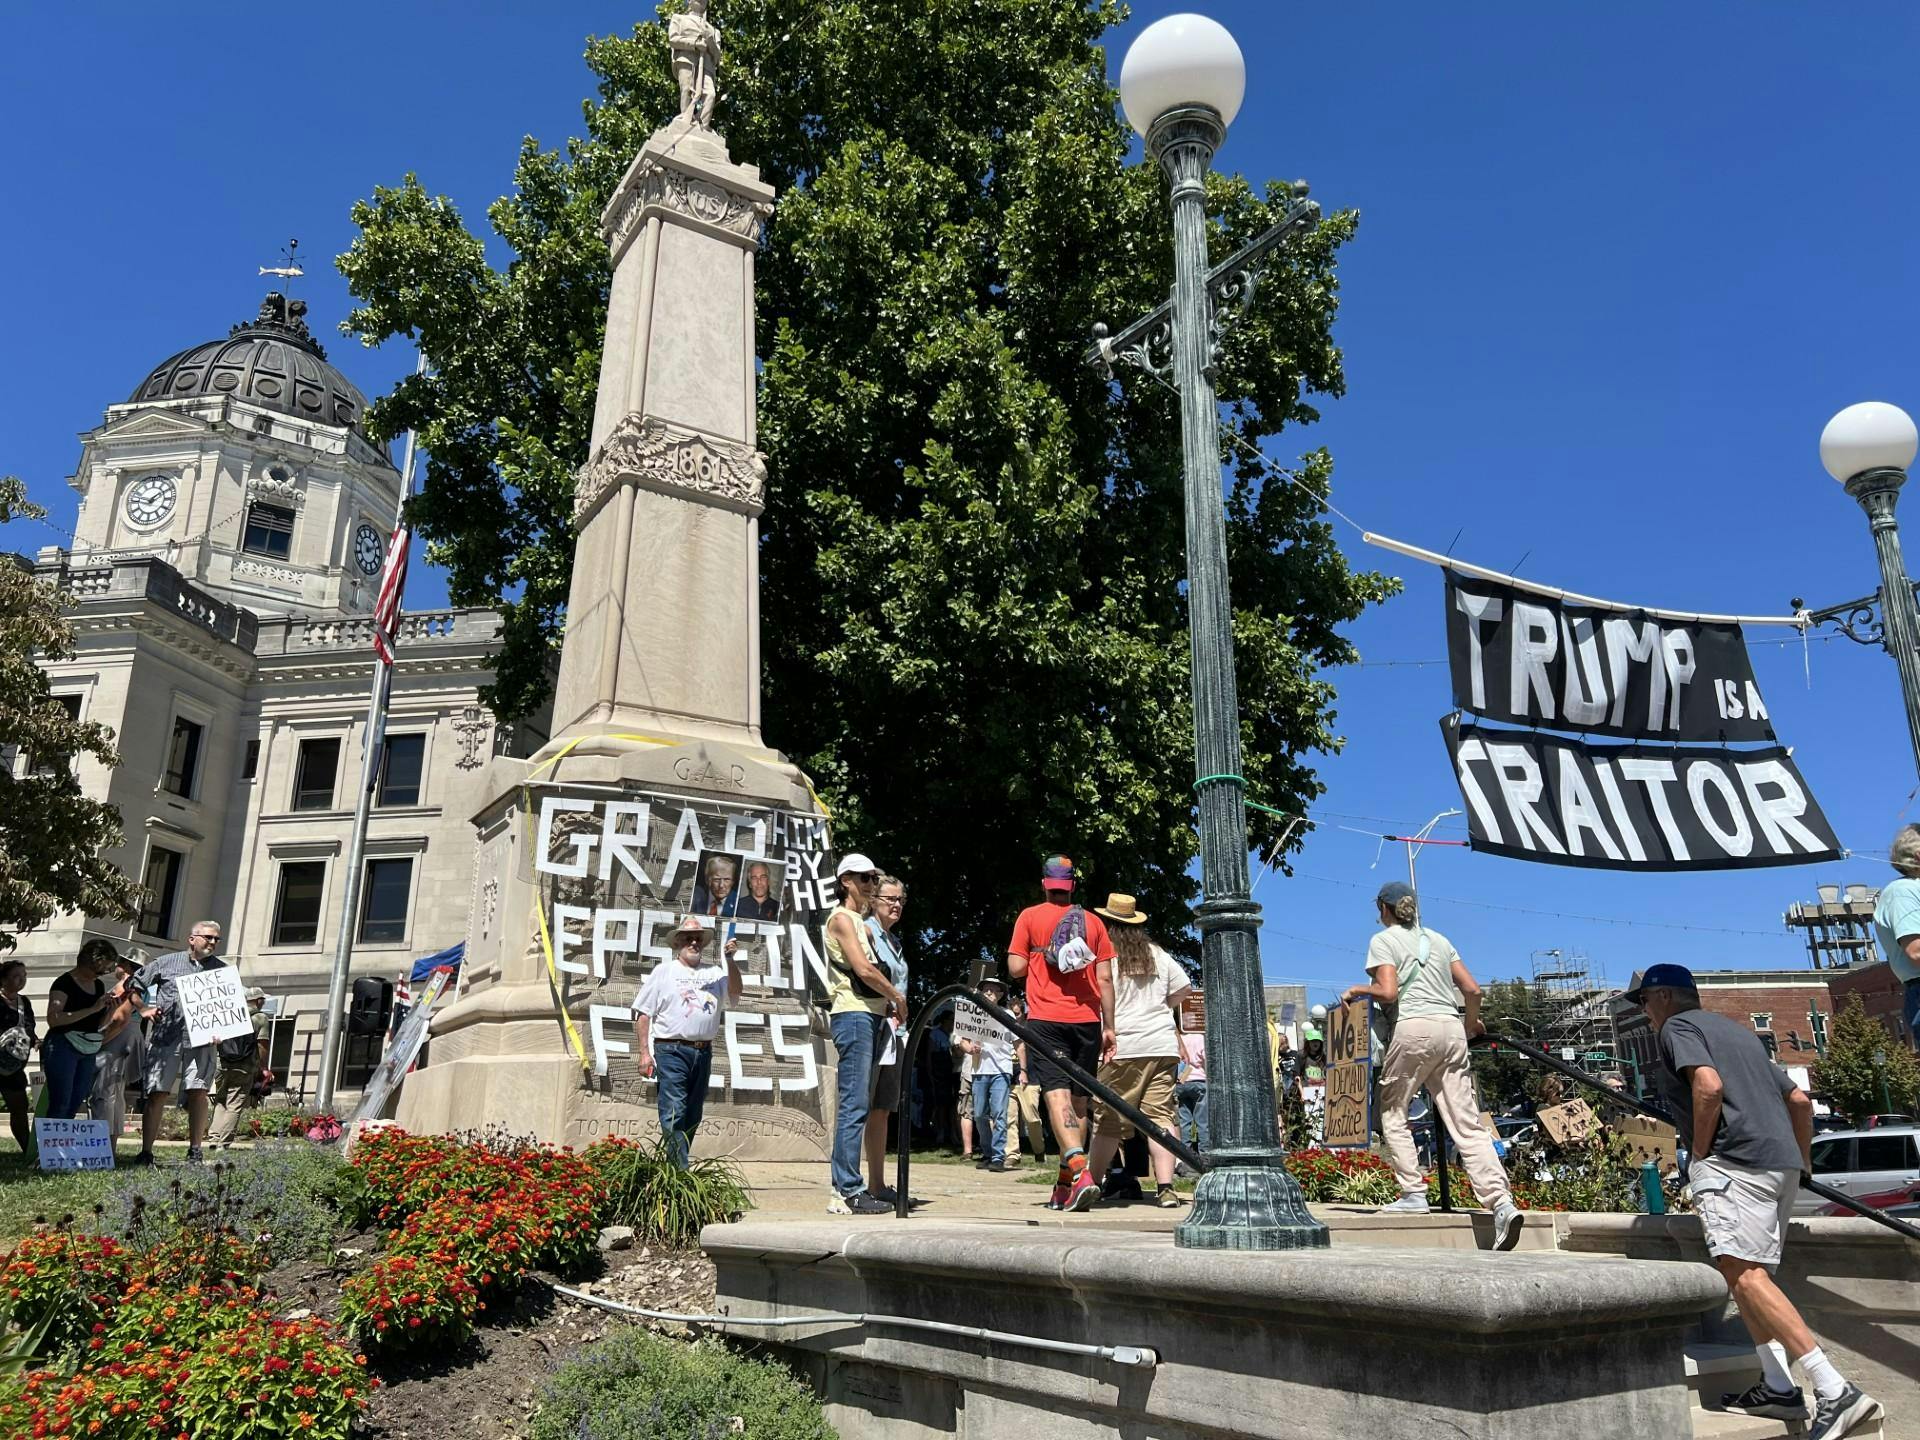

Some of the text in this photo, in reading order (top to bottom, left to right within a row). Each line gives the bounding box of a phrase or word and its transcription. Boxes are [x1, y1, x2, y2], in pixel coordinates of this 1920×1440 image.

[669, 446, 722, 484] 1861
[1456, 586, 1769, 730] TRUMP IS A
[1457, 739, 1830, 862] TRAITOR
[772, 810, 830, 850] HIM
[784, 851, 823, 880] BY
[181, 969, 225, 990] MAKE
[185, 984, 236, 1004] LYING
[187, 998, 234, 1017] WRONG
[191, 1006, 247, 1033] AGAIN!
[971, 1016, 988, 1026] NOT
[955, 1021, 1004, 1040] DEPORTATION
[1330, 1011, 1356, 1061] We
[1333, 1064, 1366, 1095] DEMAND
[72, 1123, 96, 1134] NOT
[575, 1118, 599, 1136] TO
[605, 1119, 639, 1136] THE
[43, 1137, 76, 1148] RIGHT
[84, 1137, 108, 1147] LEFT
[81, 1156, 112, 1167] RIGHT
